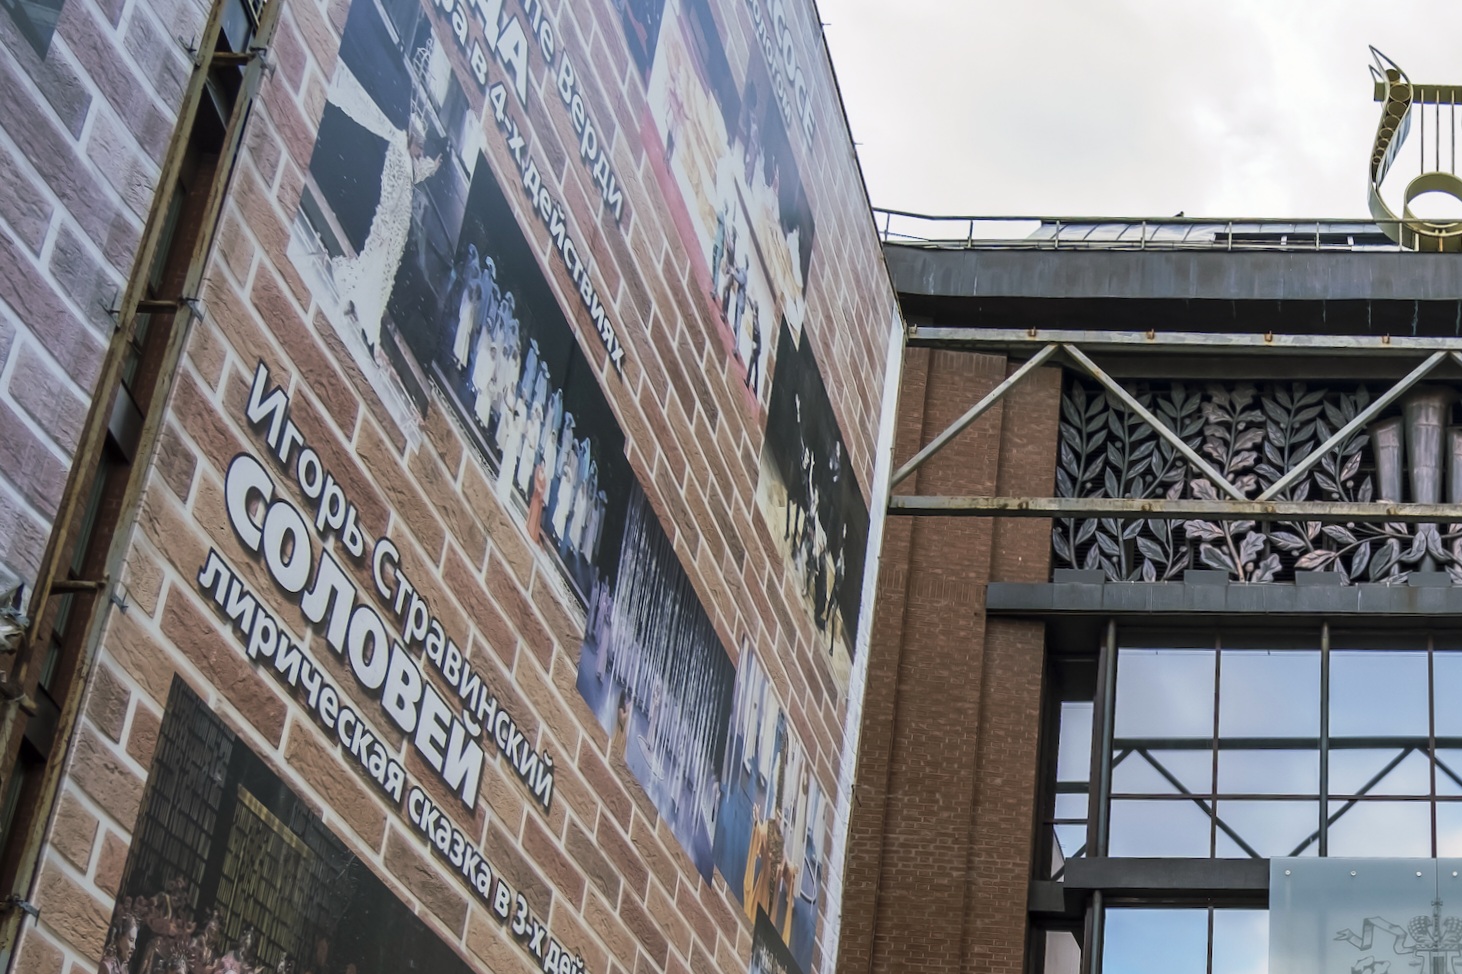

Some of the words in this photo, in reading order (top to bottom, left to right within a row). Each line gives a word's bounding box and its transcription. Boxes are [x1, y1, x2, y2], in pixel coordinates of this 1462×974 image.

[469, 37, 488, 86] в
[489, 82, 526, 166] 4-х
[521, 158, 626, 374] действиях
[556, 49, 623, 218] Верди
[197, 547, 406, 804] лирическая
[407, 784, 494, 900] сказка
[493, 877, 512, 919] в
[511, 893, 548, 959] 3-х
[224, 451, 485, 811] СОЛОВЕЙ
[245, 359, 365, 558] Игорь
[371, 535, 554, 808] Стравинский
